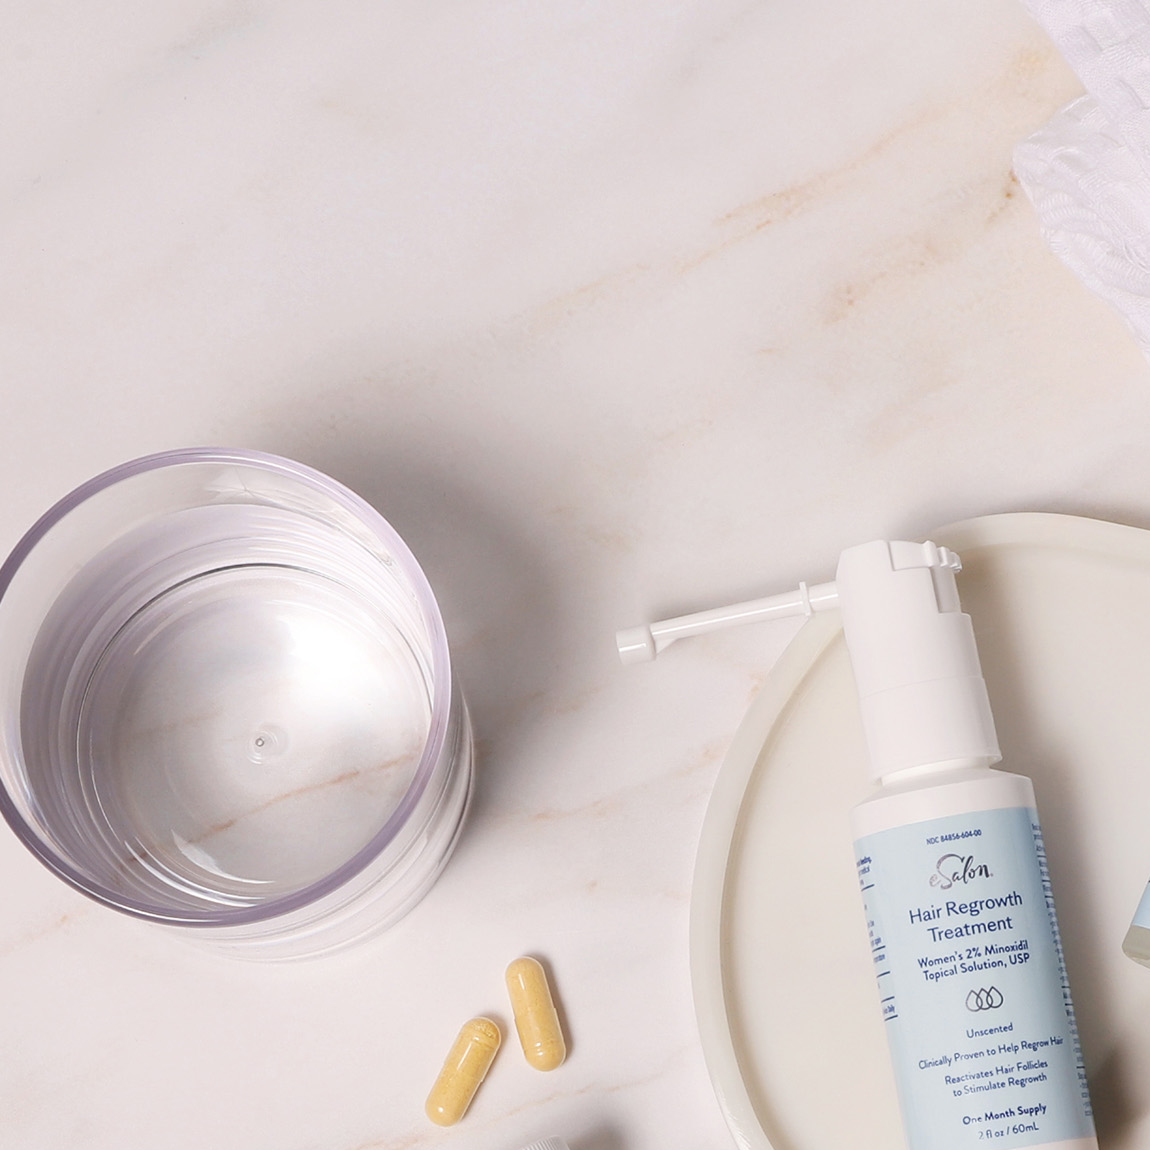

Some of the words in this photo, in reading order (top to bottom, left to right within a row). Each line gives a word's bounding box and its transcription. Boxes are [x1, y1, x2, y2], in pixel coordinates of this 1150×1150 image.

[926, 836, 940, 845] NDC
[909, 904, 943, 925] Hair
[945, 891, 1023, 917] Regrowth
[927, 916, 1014, 943] Treatment
[917, 951, 963, 969] Women's
[965, 947, 982, 960] 2%
[984, 939, 1029, 957] Minoxidil
[922, 965, 958, 982] Topical
[960, 958, 1008, 974] Solution,
[1008, 952, 1030, 966] USP
[966, 1022, 1014, 1039] Unscented
[918, 1055, 953, 1071] Clinically
[953, 1050, 985, 1063] Proven
[986, 1046, 997, 1057] to
[998, 1042, 1020, 1056] Help
[1020, 1039, 1050, 1052] Regrow
[1049, 1036, 1064, 1047] Hair
[944, 1065, 994, 1086] Reactivates
[996, 1063, 1015, 1076] Hair
[1016, 1059, 1048, 1072] Follicles
[953, 1087, 963, 1098] to
[963, 1080, 1007, 1095] Stimulate
[1007, 1072, 1048, 1089] Regrowth
[962, 1115, 983, 1126] One
[984, 1108, 1016, 1122] Month
[1017, 1103, 1048, 1119] Supply
[978, 1130, 985, 1140] 2
[994, 1129, 1005, 1138] oz
[1012, 1122, 1040, 1135] 60mL
